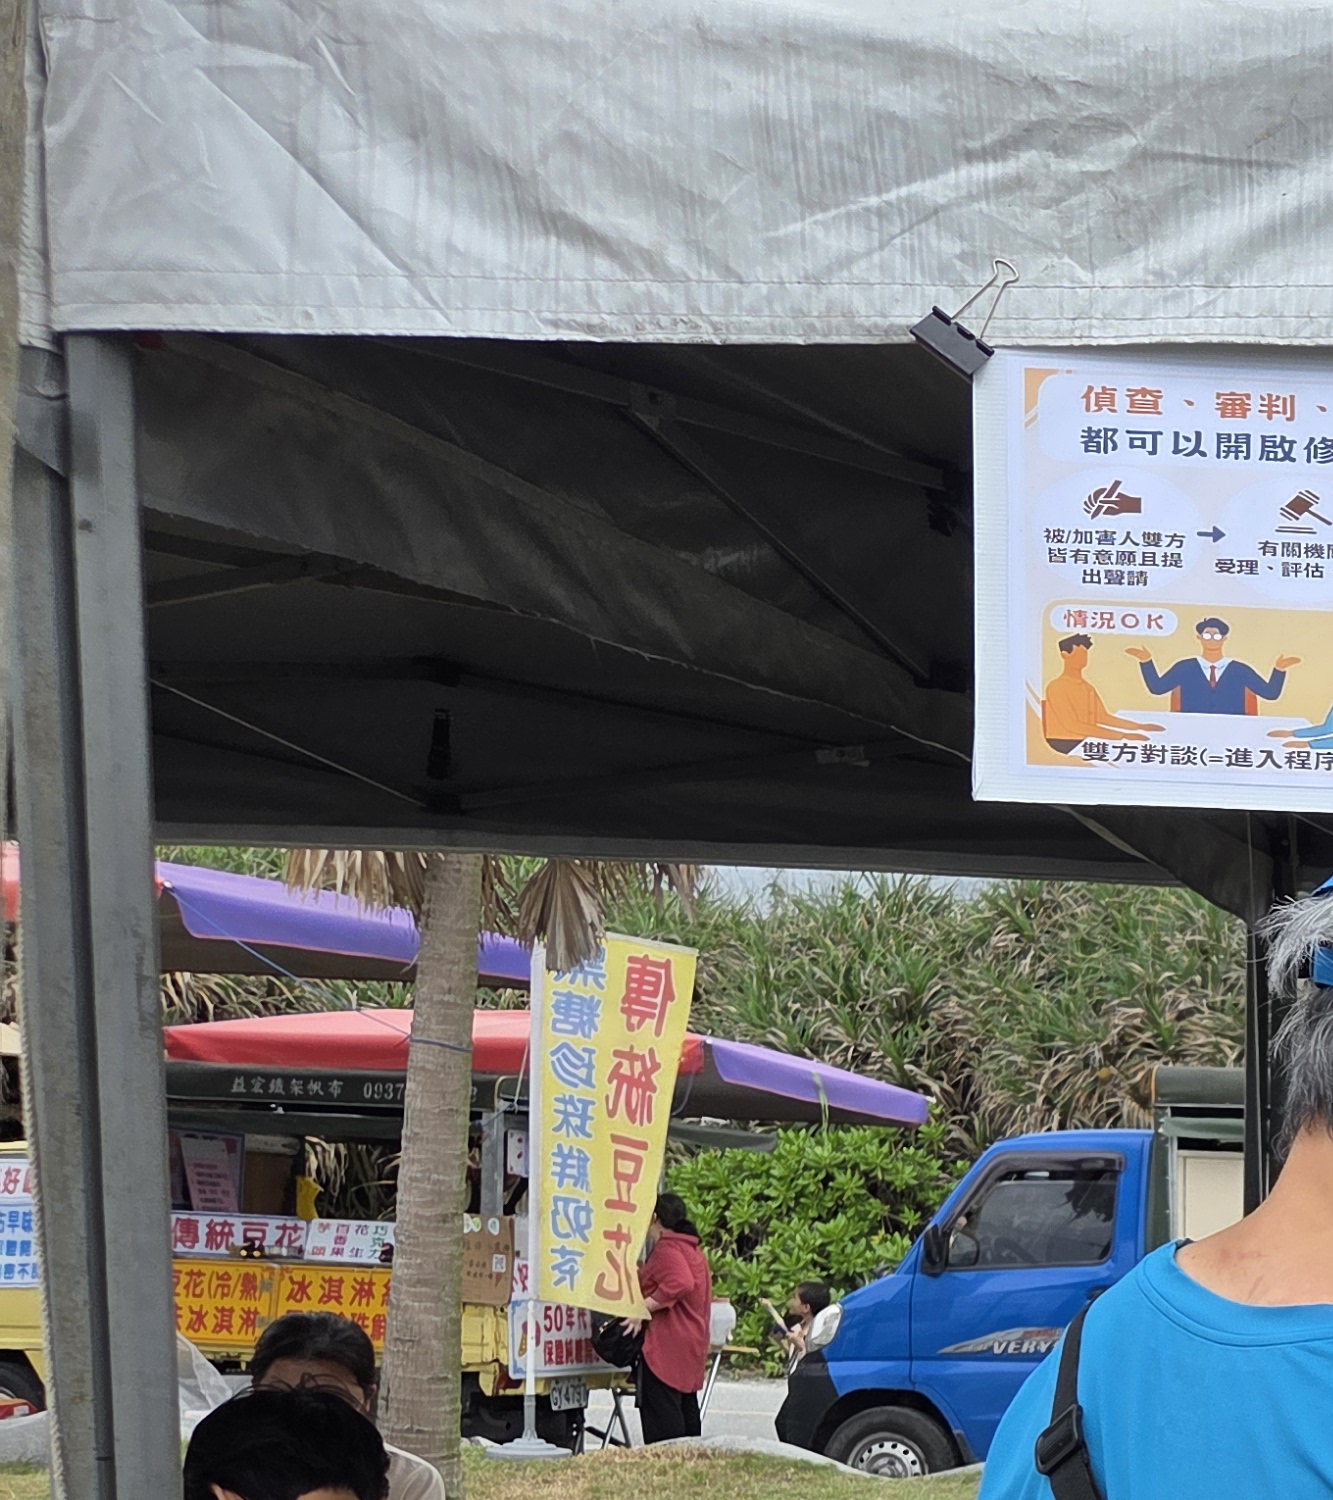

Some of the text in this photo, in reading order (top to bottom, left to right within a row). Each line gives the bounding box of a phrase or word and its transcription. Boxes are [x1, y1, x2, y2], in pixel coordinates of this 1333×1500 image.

[1044, 528, 1186, 549] 被/加害人雙方
[1048, 548, 1184, 569] 皆有意願且提
[1082, 568, 1149, 587] 出聲請
[172, 1217, 304, 1252] 傳統豆花
